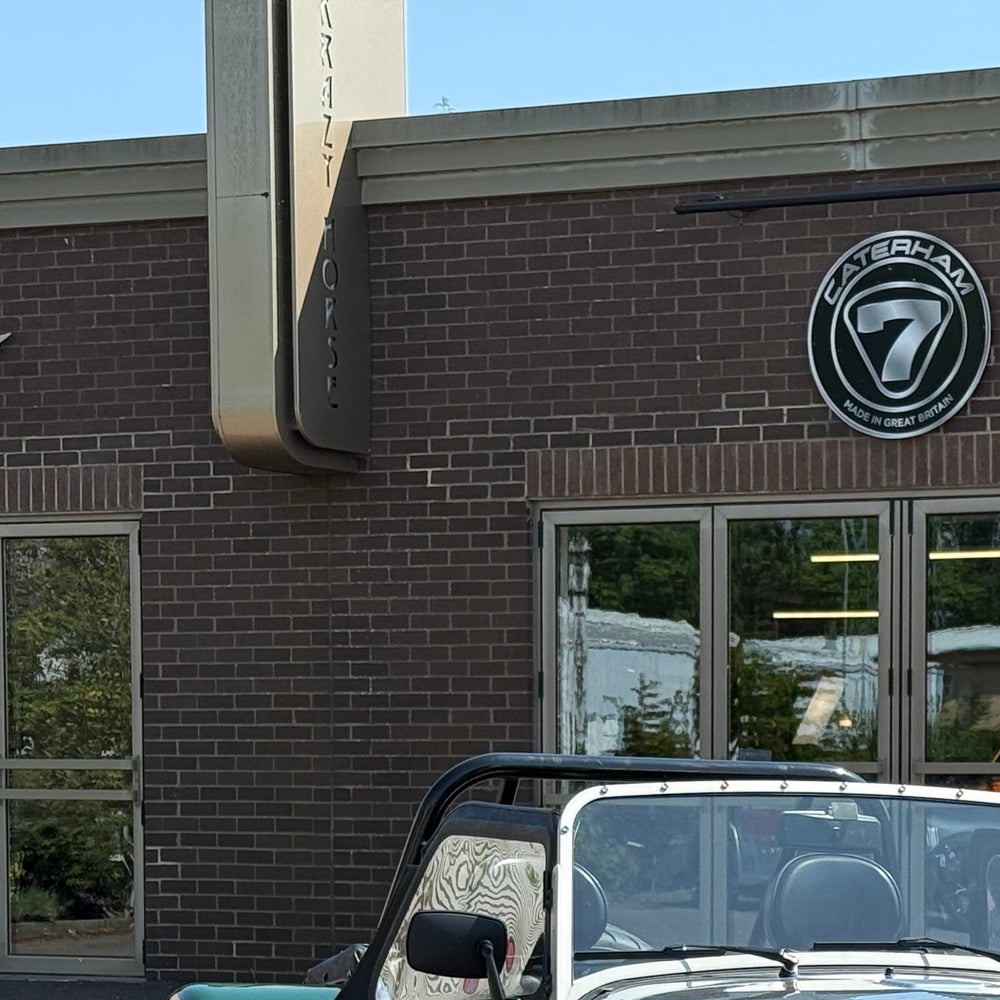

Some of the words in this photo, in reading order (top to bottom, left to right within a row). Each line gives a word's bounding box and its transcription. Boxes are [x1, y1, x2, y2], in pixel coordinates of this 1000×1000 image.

[823, 238, 975, 306] CATERHAM
[857, 298, 942, 383] 7
[843, 399, 871, 422] MADE
[871, 415, 883, 426] IN
[883, 416, 916, 428] GREAT
[917, 394, 954, 423] BRITAIN
